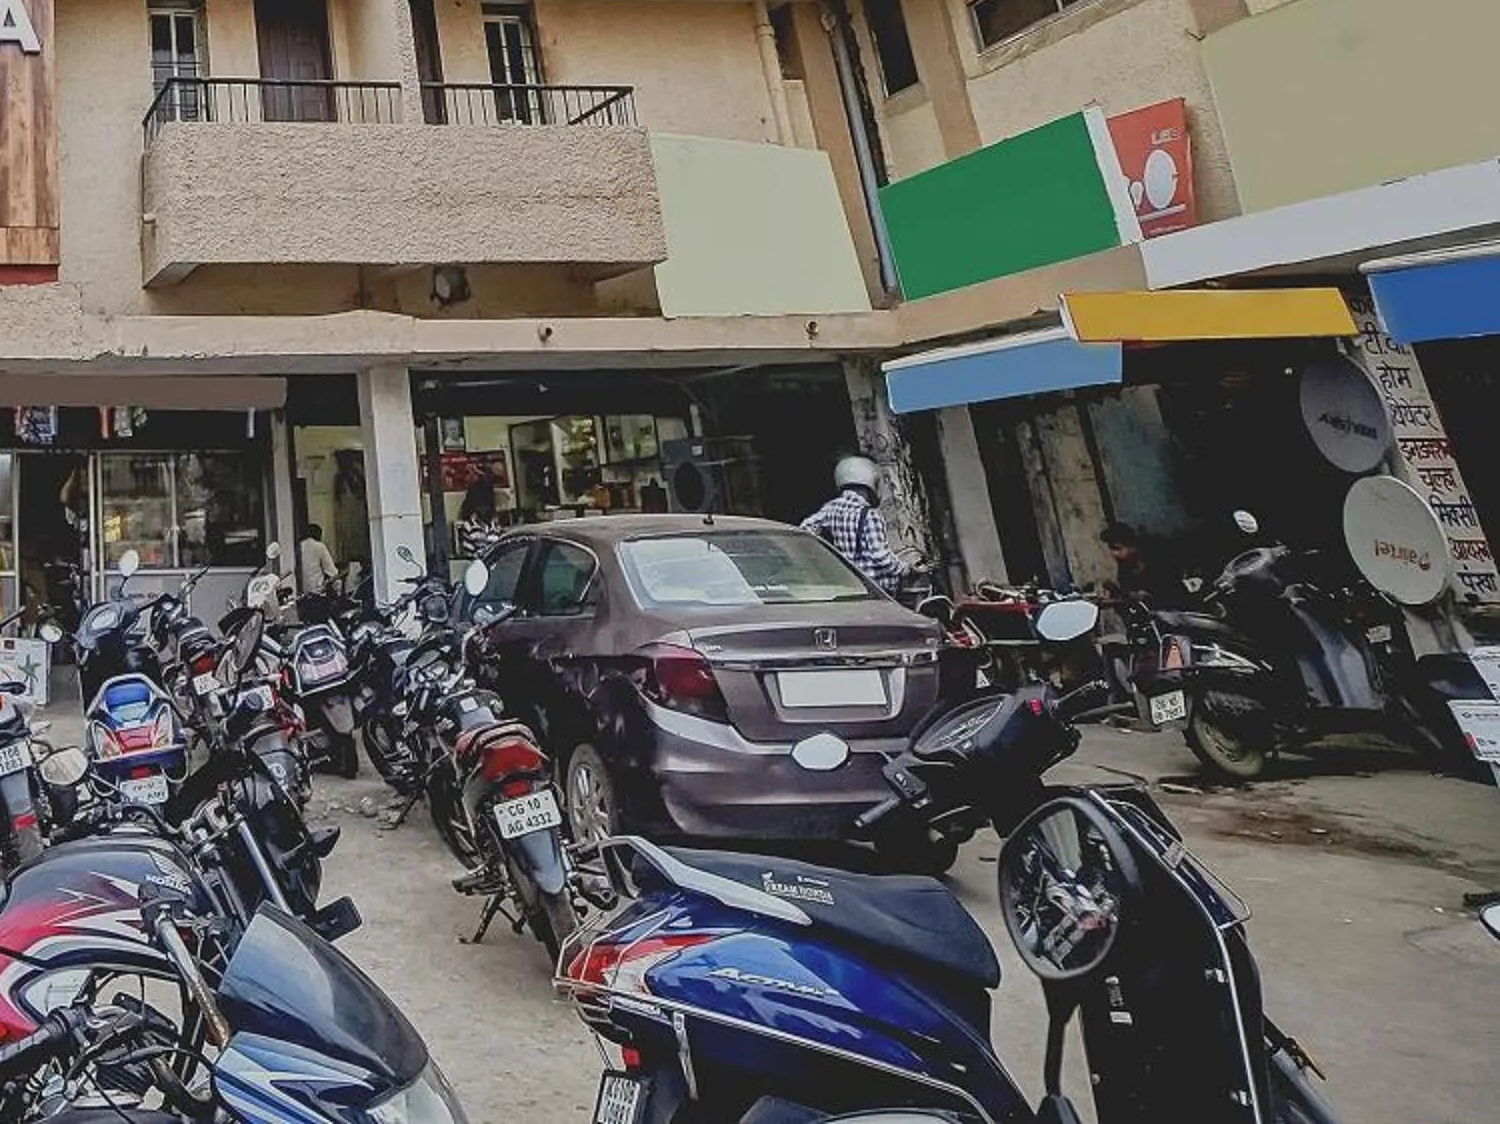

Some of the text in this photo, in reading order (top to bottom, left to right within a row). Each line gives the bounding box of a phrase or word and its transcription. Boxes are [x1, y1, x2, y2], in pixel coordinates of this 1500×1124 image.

[507, 797, 541, 817] CG 10
[507, 811, 553, 835] AG 4332
